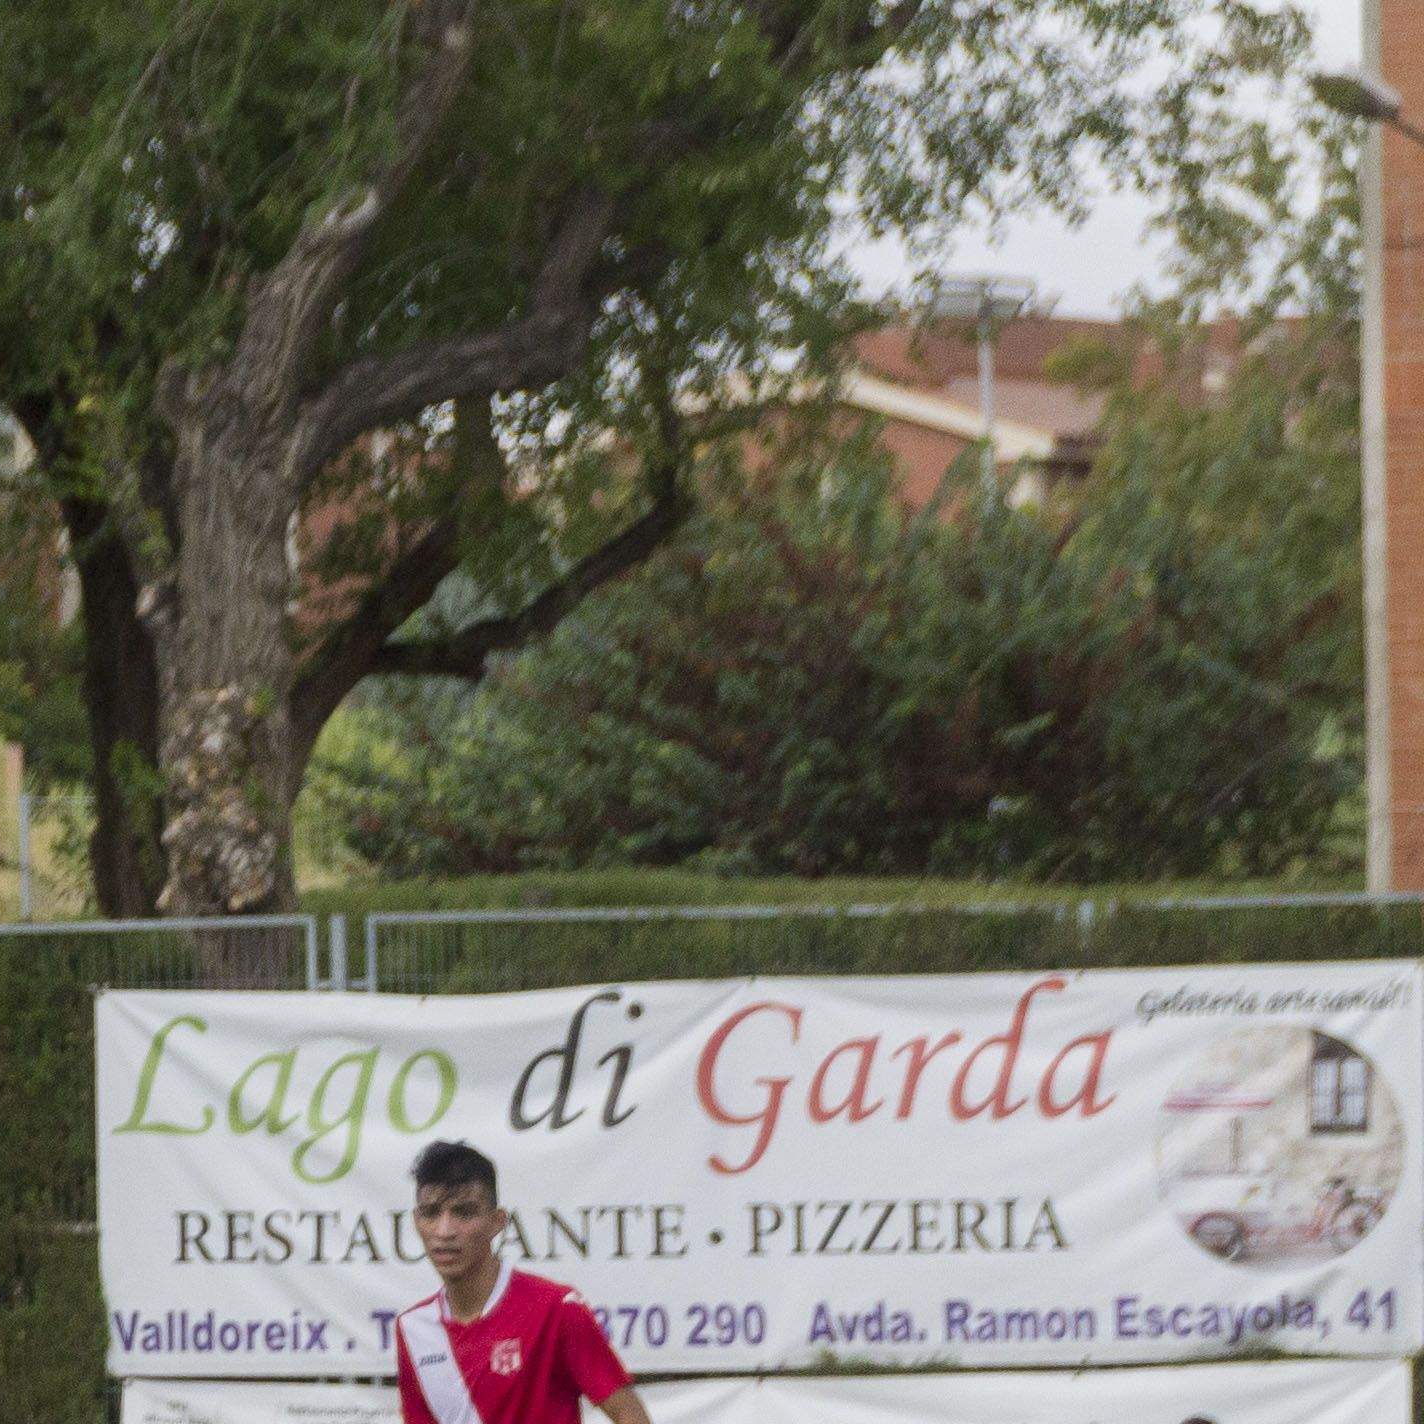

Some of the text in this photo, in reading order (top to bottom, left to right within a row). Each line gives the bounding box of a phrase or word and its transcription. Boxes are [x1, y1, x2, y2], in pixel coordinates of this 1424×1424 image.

[112, 977, 1119, 1184] Lago di Garda
[174, 1194, 1071, 1264] RESTAUANTE PIZZERIA
[112, 1309, 329, 1353] Valldoreix
[685, 1302, 767, 1348] 290
[808, 1300, 926, 1344] Avda.
[944, 1298, 1097, 1343] Ramon
[1114, 1293, 1332, 1348] Escayola,
[1344, 1288, 1398, 1331] 41
